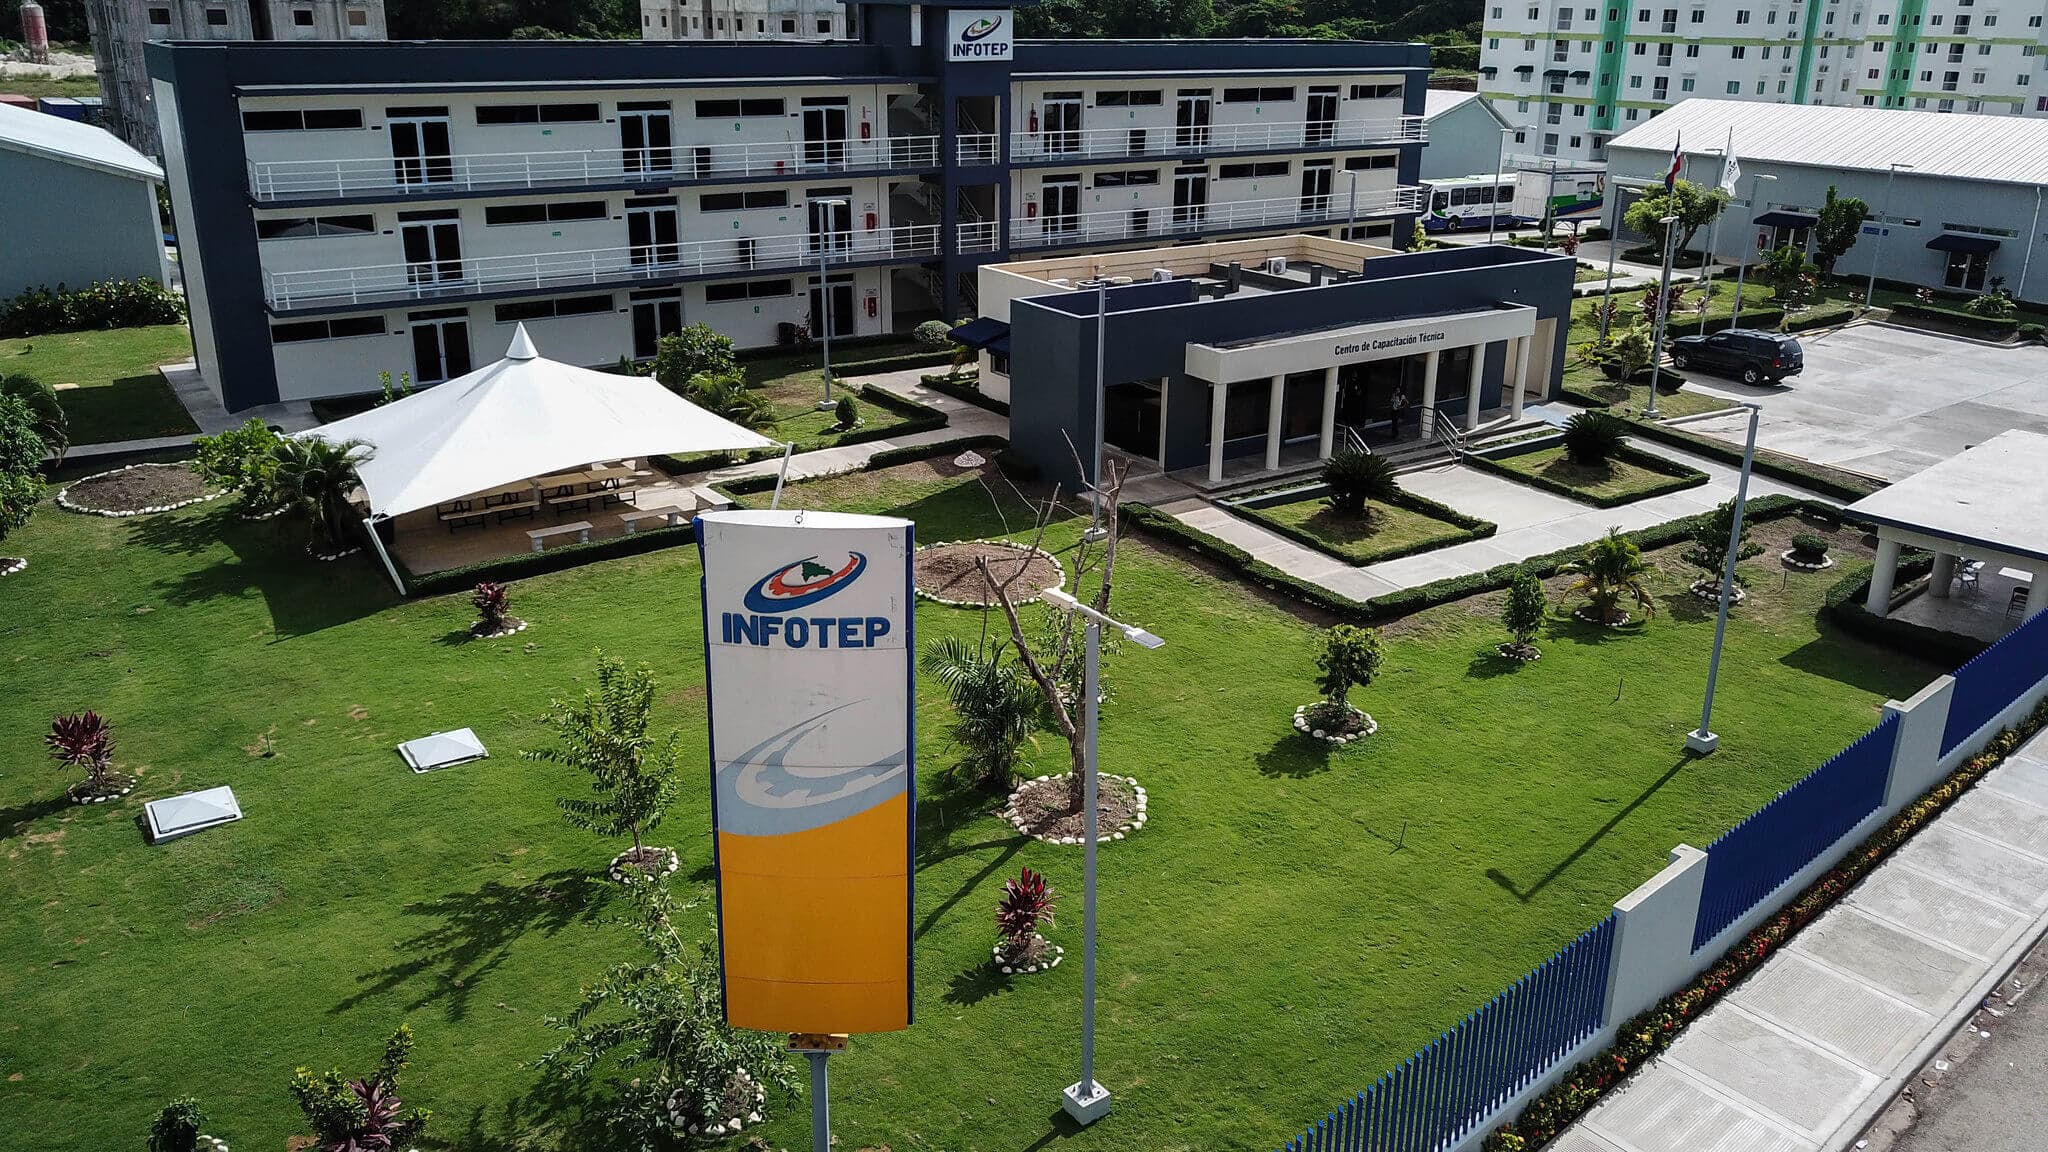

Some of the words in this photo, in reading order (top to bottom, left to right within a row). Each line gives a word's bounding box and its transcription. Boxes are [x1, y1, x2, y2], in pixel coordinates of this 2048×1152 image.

[953, 43, 1008, 56] INFOTEP
[1334, 344, 1359, 355] Centro
[1361, 342, 1370, 351] de
[1372, 335, 1417, 350] Capacitación
[1419, 332, 1445, 342] Técnica
[722, 612, 891, 649] INFOTEP
